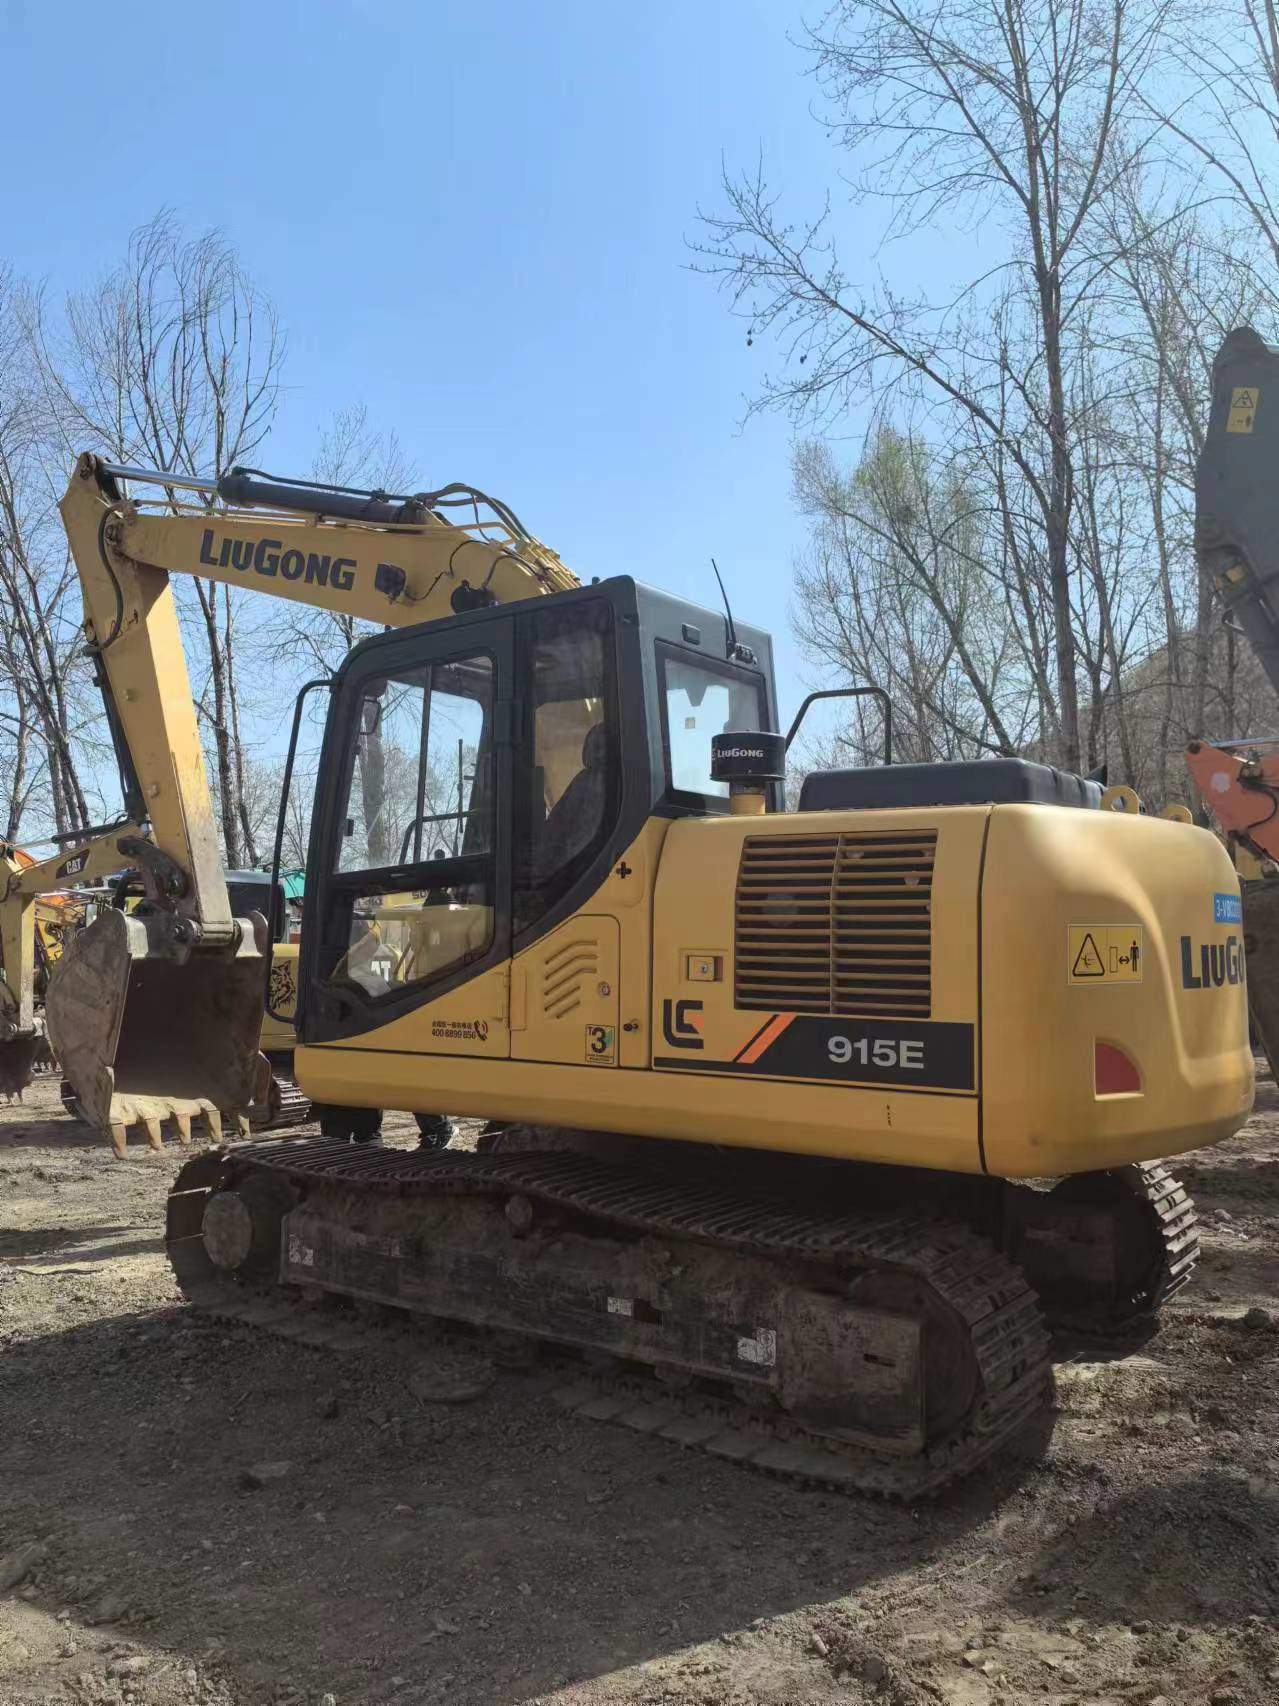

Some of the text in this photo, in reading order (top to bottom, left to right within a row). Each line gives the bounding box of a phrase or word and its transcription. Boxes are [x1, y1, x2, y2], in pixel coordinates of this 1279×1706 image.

[66, 859, 81, 874] CAT
[371, 960, 390, 982] AT
[1181, 935, 1245, 989] LIUGO
[432, 1028, 444, 1038] 400
[827, 1035, 924, 1069] 915E
